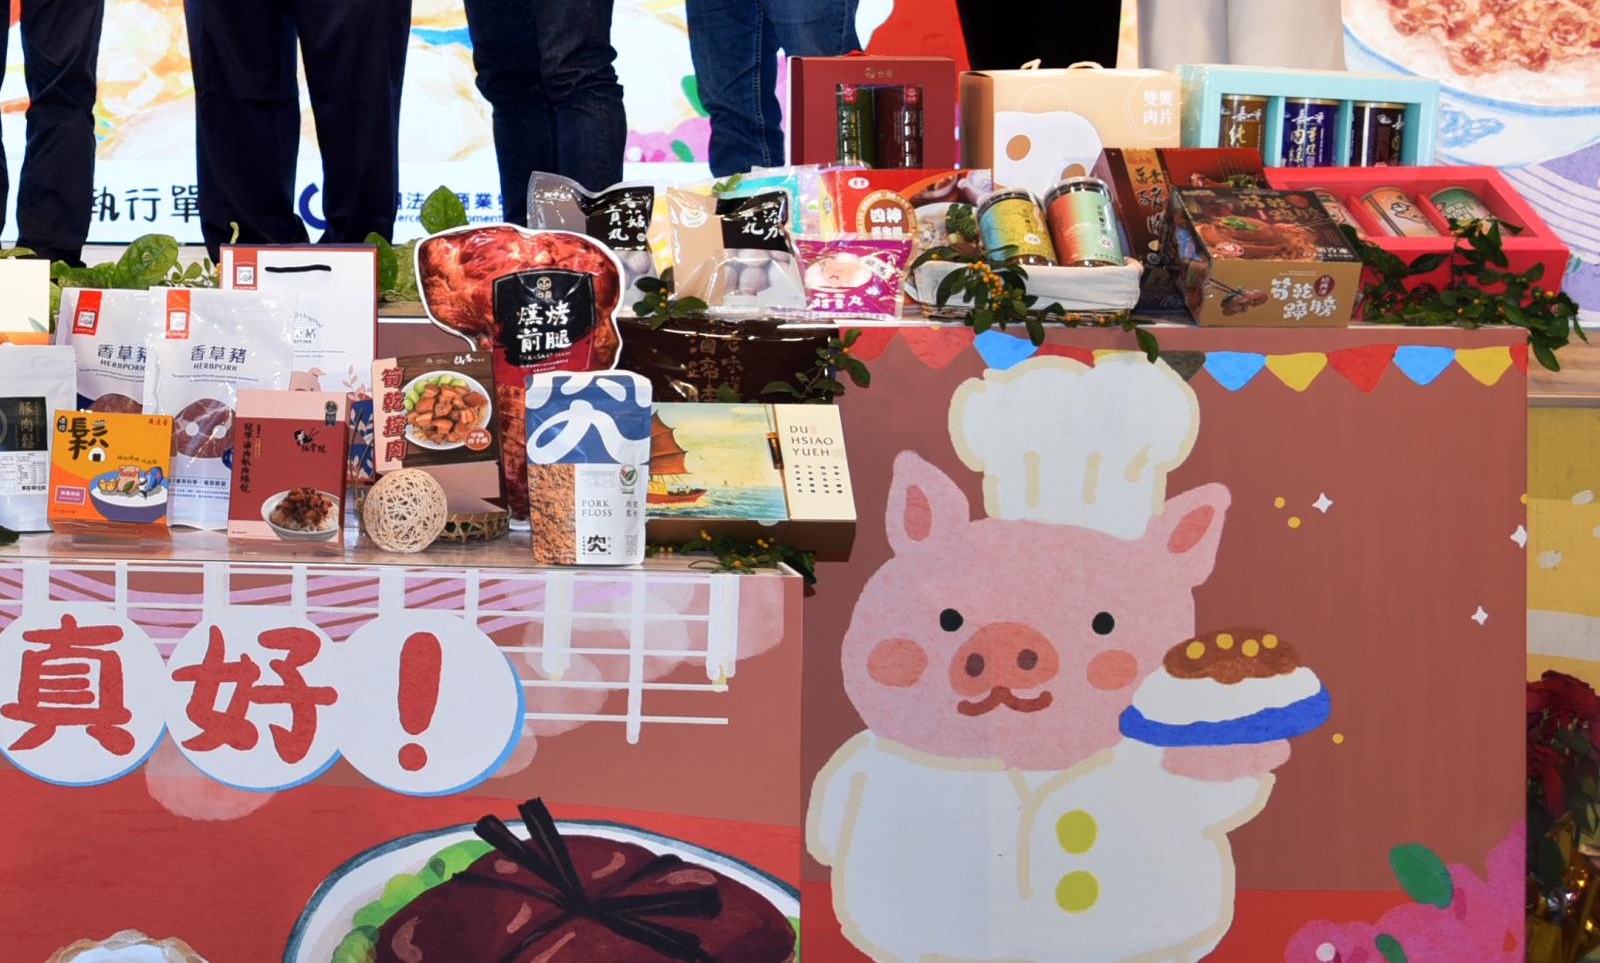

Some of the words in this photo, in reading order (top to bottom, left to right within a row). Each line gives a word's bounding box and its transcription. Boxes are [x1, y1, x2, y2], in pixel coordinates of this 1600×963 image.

[1142, 109, 1175, 127] 肉片
[869, 208, 903, 224] 四神
[516, 300, 572, 326] 燻烤
[516, 329, 573, 353] 前腿
[190, 344, 247, 365] 香草豬
[193, 363, 238, 372] HERBPORK
[789, 425, 809, 434] DU
[791, 437, 834, 446] HSIAO
[792, 448, 831, 457] YUEH
[581, 499, 610, 508] PORK
[581, 509, 614, 517] FLOSS
